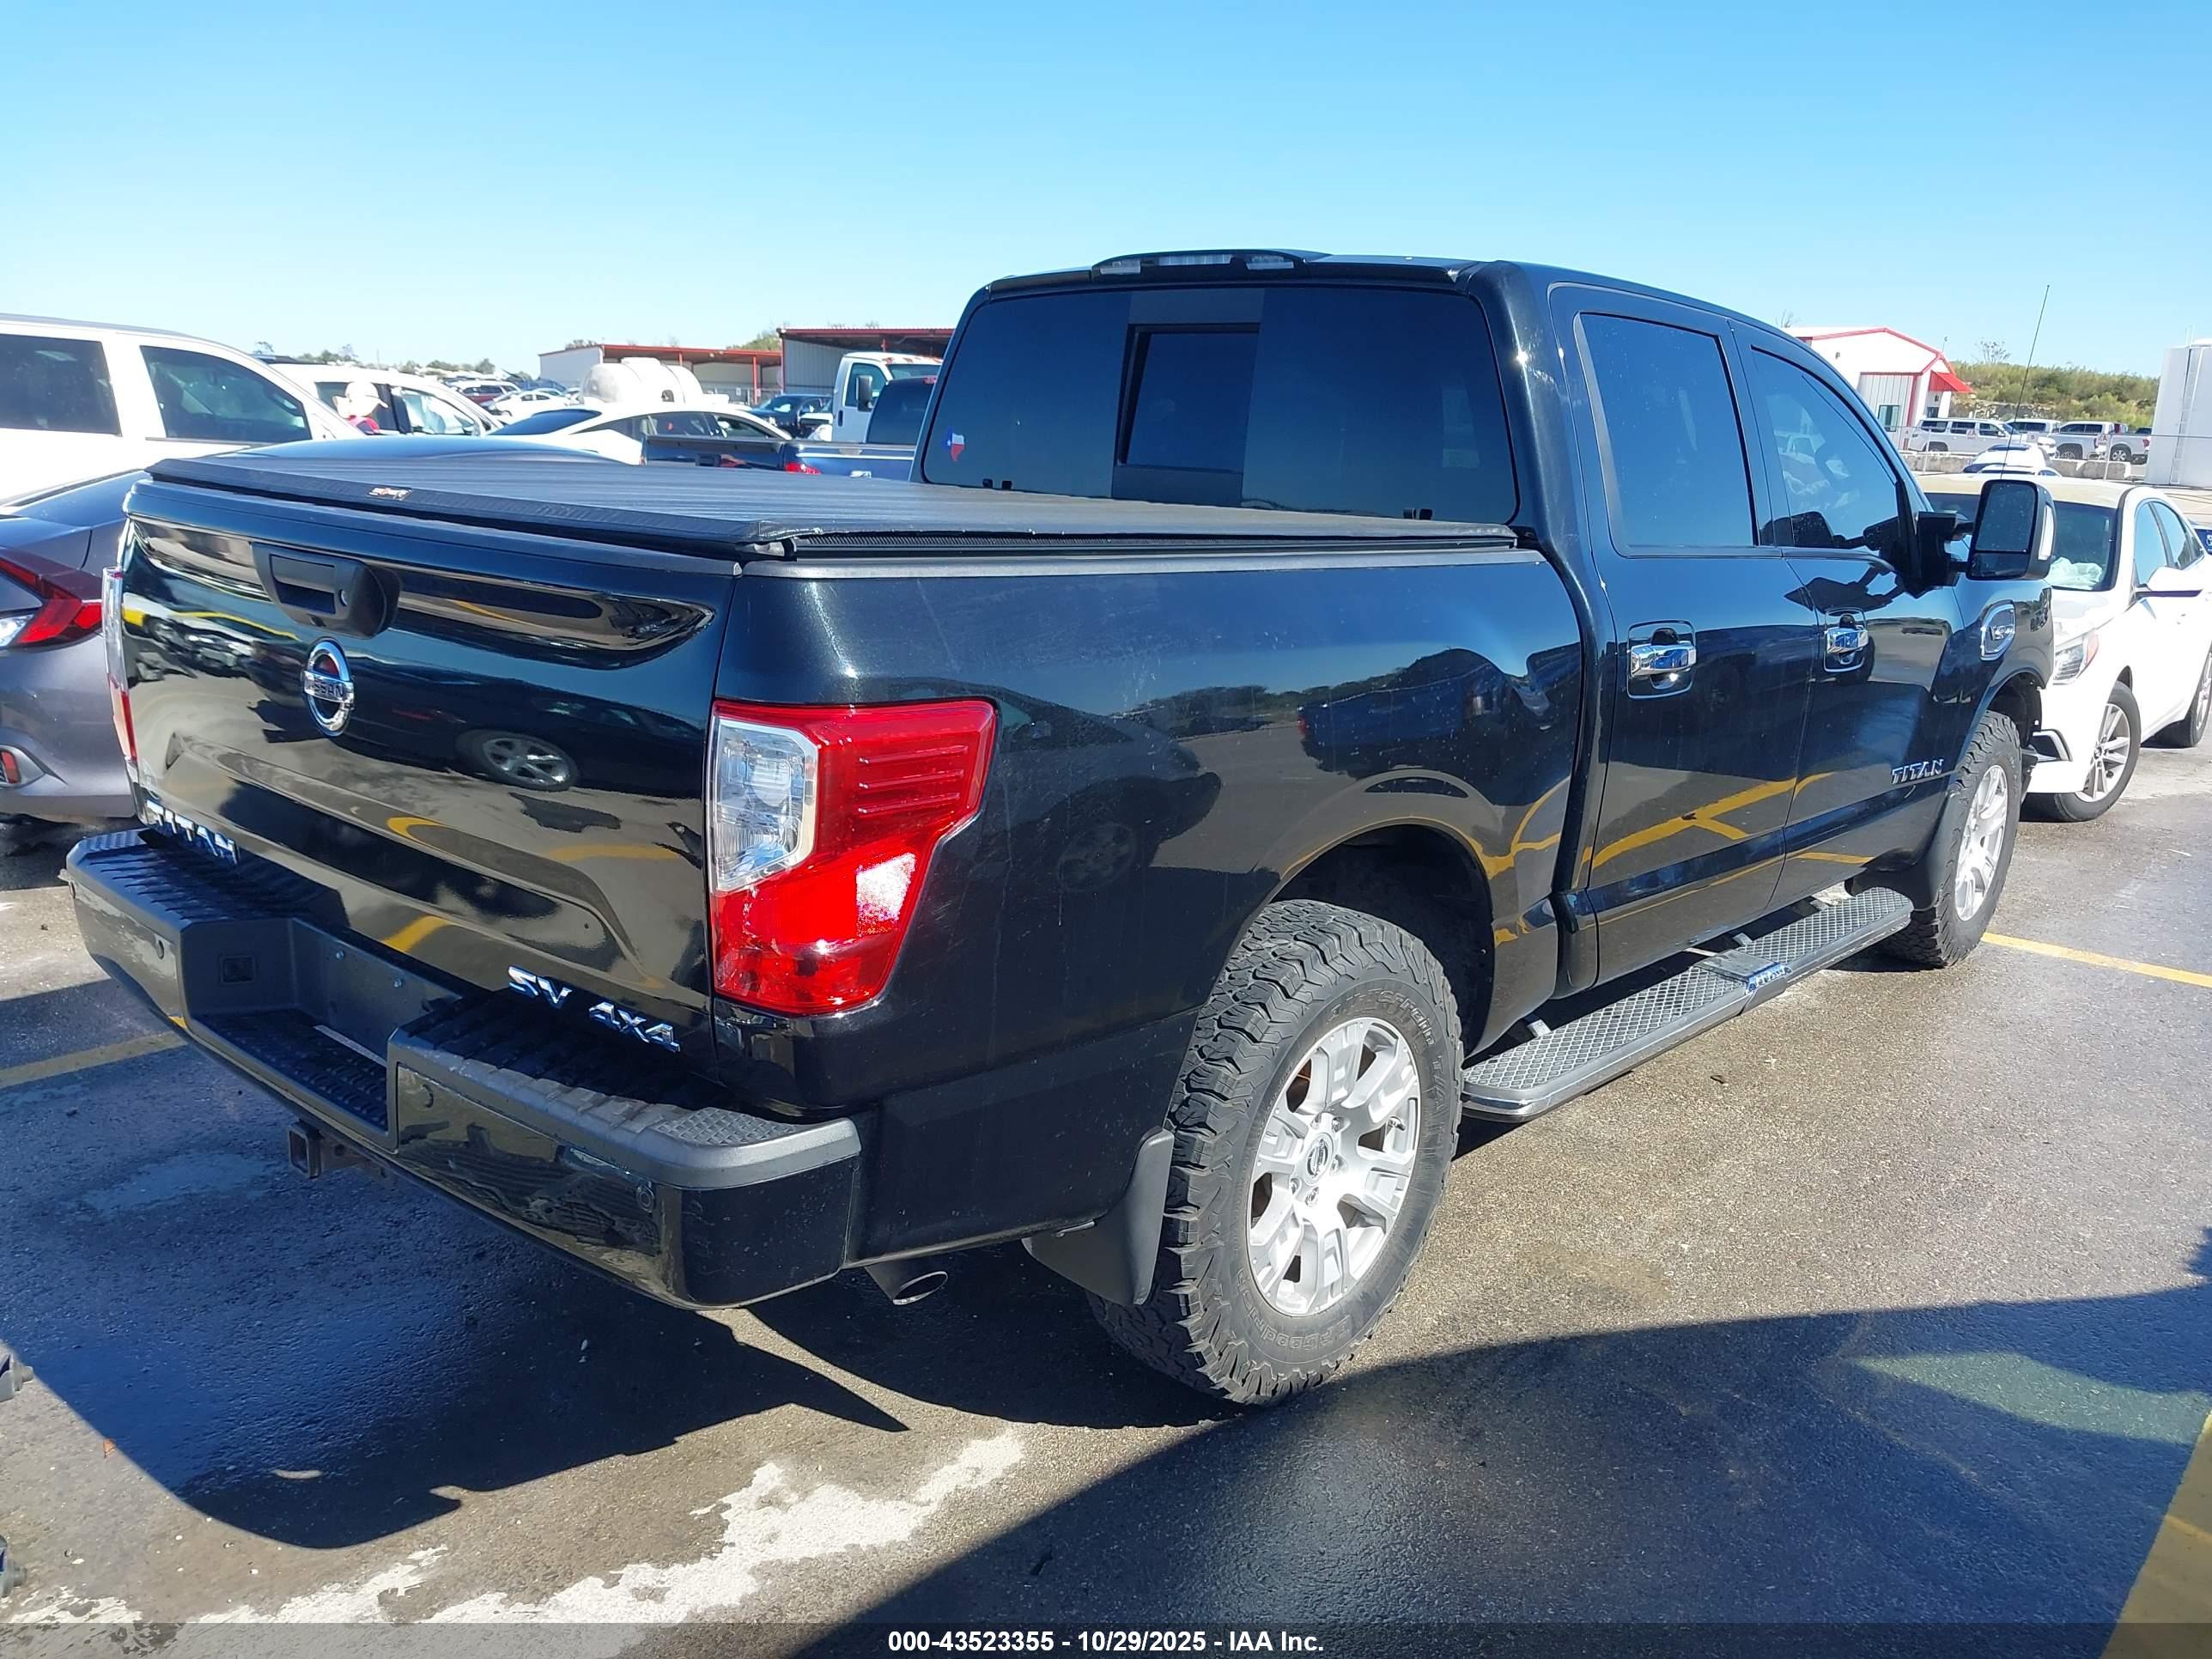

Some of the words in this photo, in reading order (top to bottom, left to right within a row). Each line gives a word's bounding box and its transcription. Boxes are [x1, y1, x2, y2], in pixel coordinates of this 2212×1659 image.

[306, 676, 345, 699] SSAN
[1892, 758, 1944, 785] TITAN
[143, 799, 239, 865] TITAN
[508, 967, 573, 1006] SV
